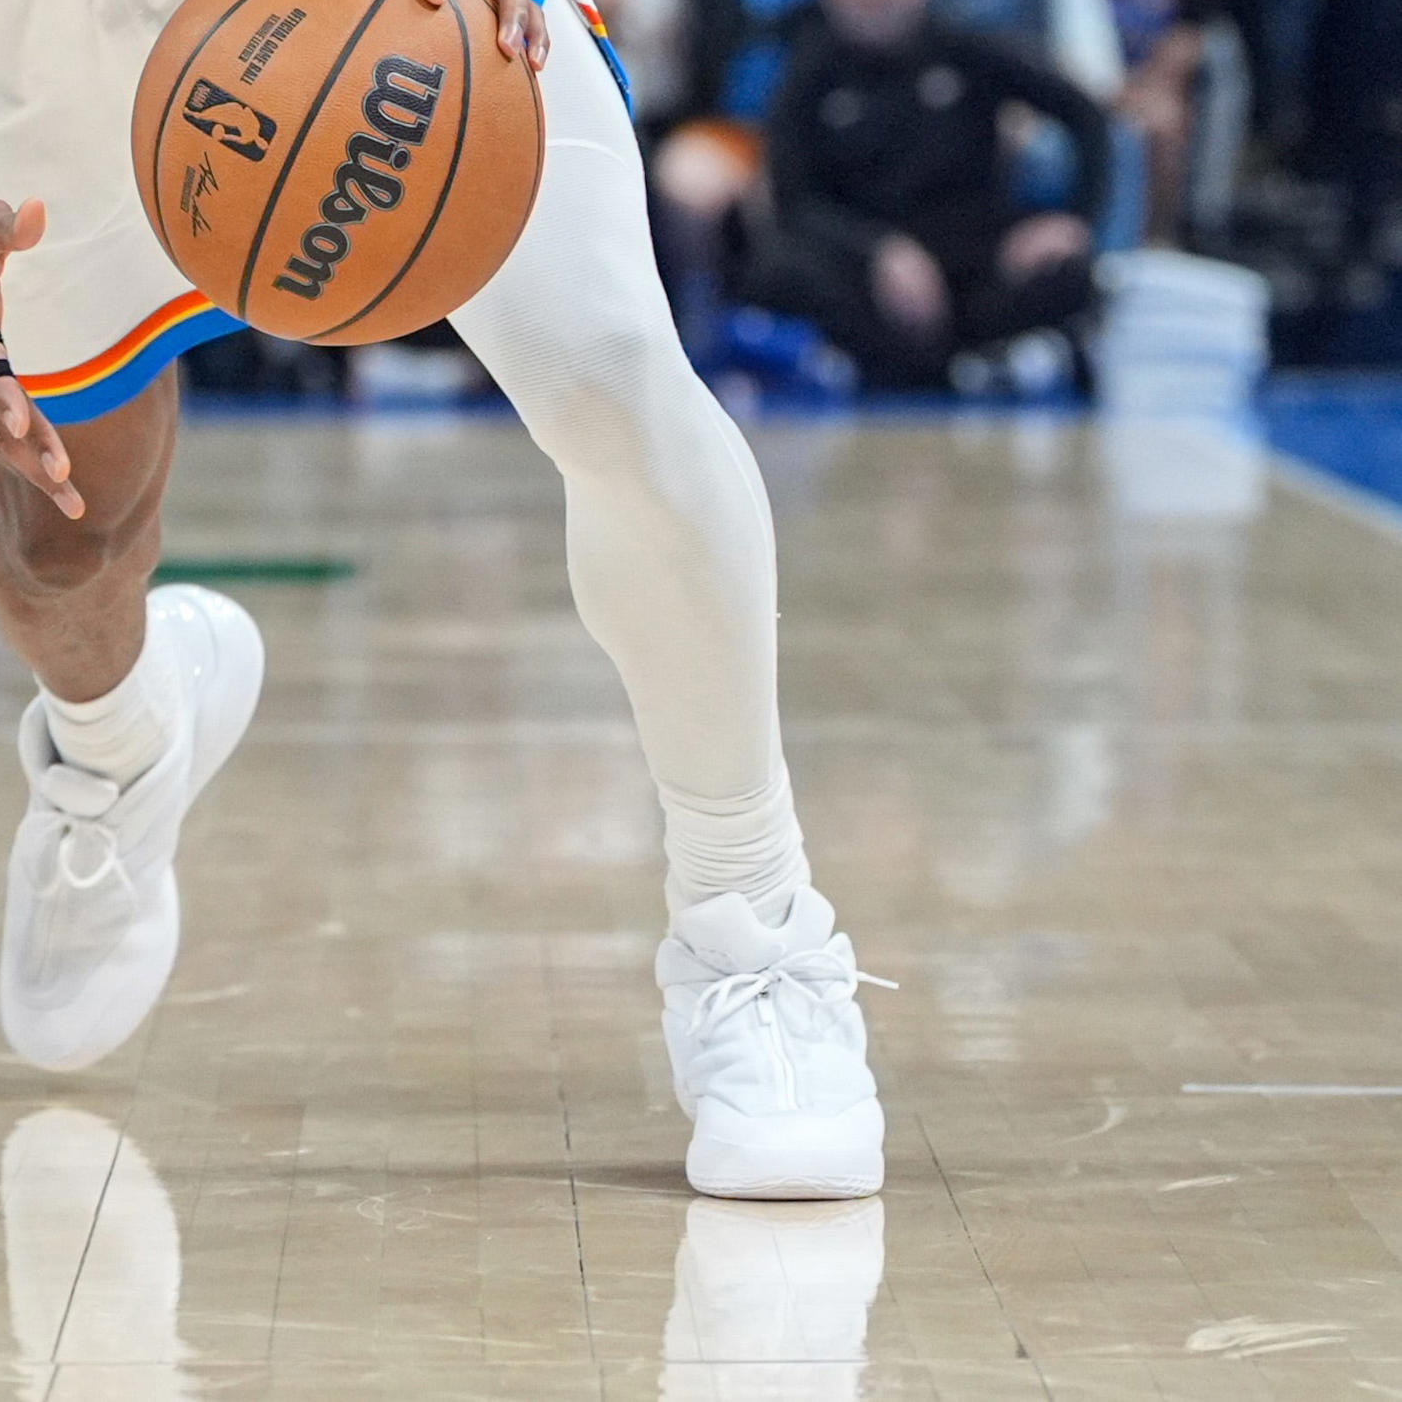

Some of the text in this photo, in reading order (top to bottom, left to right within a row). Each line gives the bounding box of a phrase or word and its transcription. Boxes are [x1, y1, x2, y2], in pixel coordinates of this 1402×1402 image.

[239, 7, 307, 85] OFFICIAL GAME BALL
[272, 54, 447, 301] Wilson
